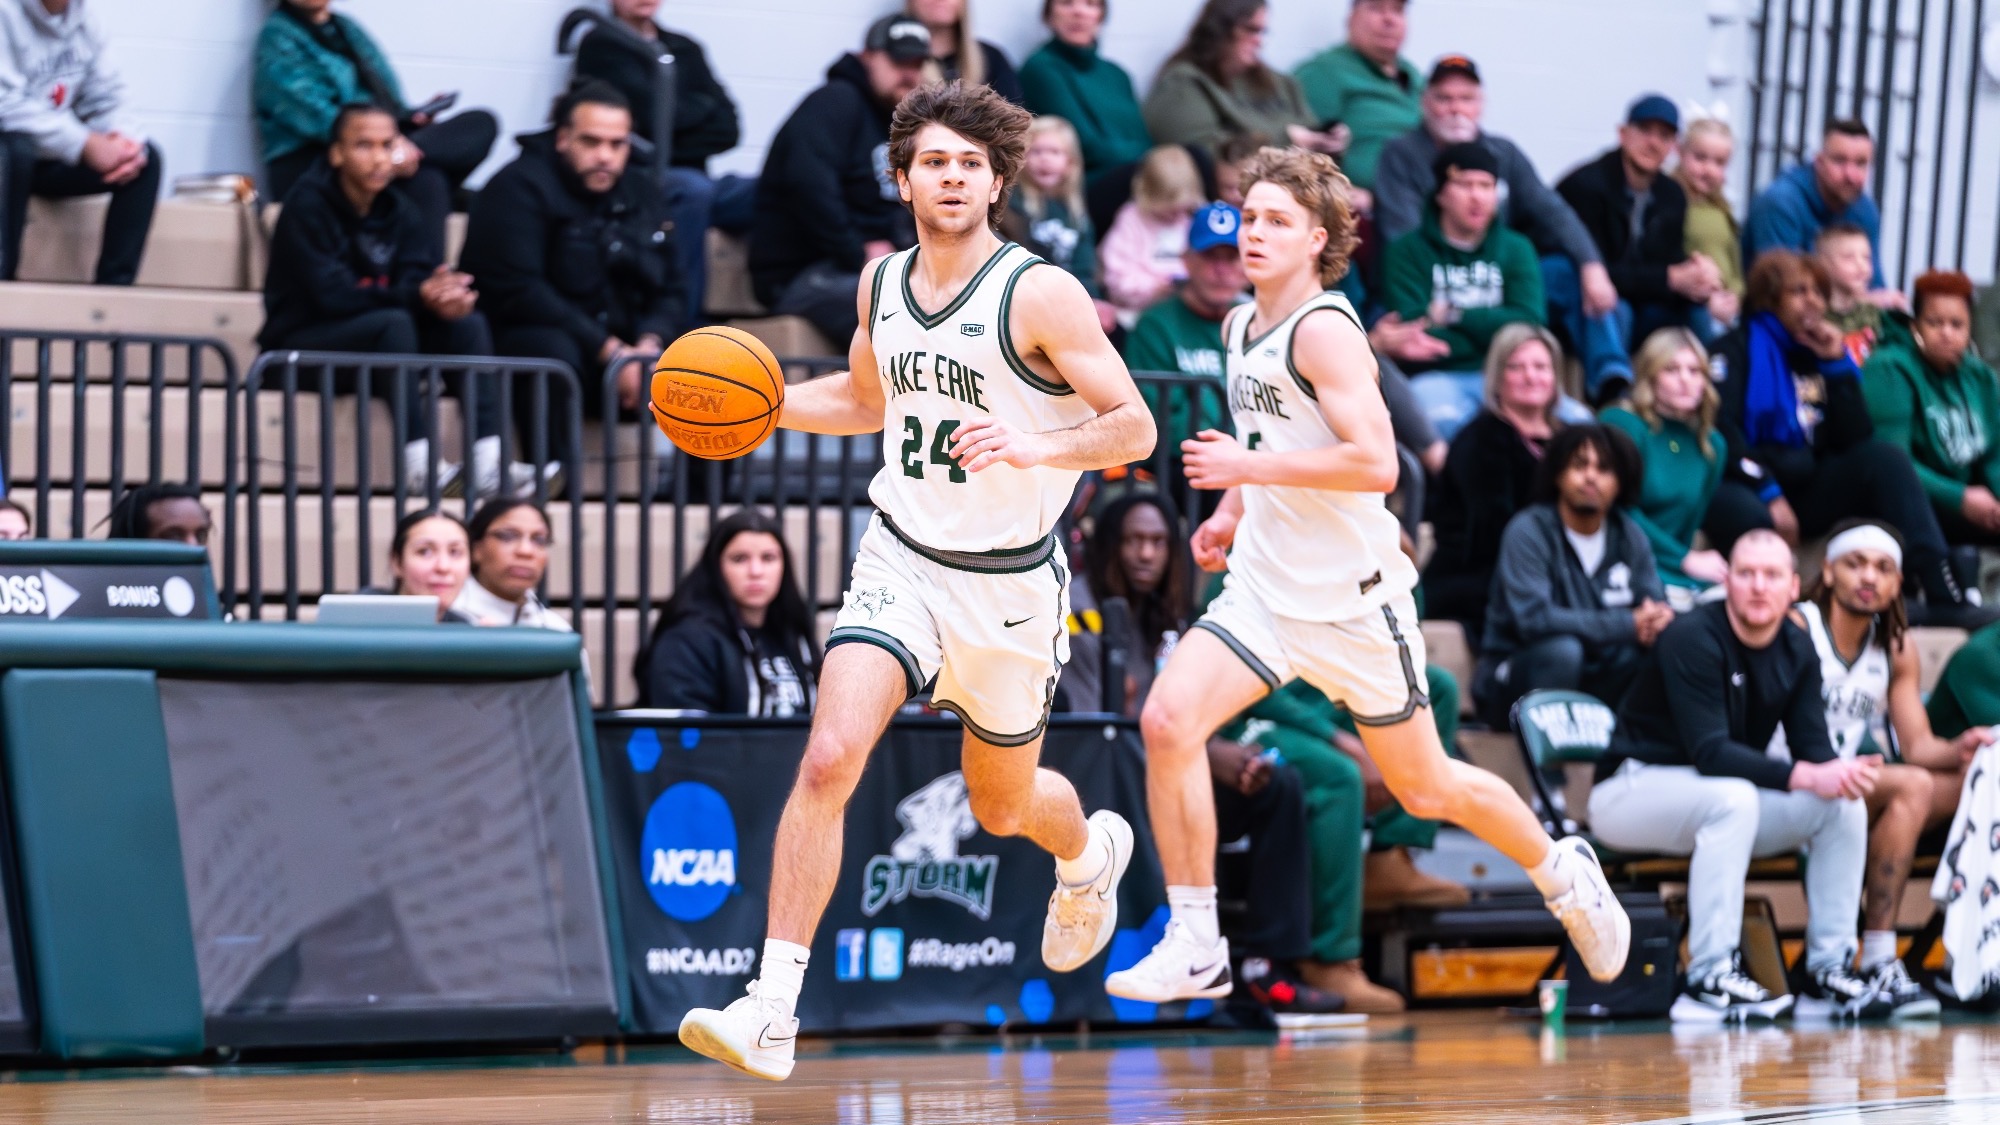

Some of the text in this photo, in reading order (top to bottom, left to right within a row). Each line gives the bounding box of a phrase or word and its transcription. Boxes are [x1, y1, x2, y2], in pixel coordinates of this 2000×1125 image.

[665, 386, 725, 414] NCAA
[883, 351, 990, 414] AKE ERIE
[901, 415, 967, 484] 24
[106, 585, 161, 607] BONUS
[650, 848, 736, 886] NCAA
[861, 855, 999, 921] STORM
[908, 936, 1017, 972] #RageOn
